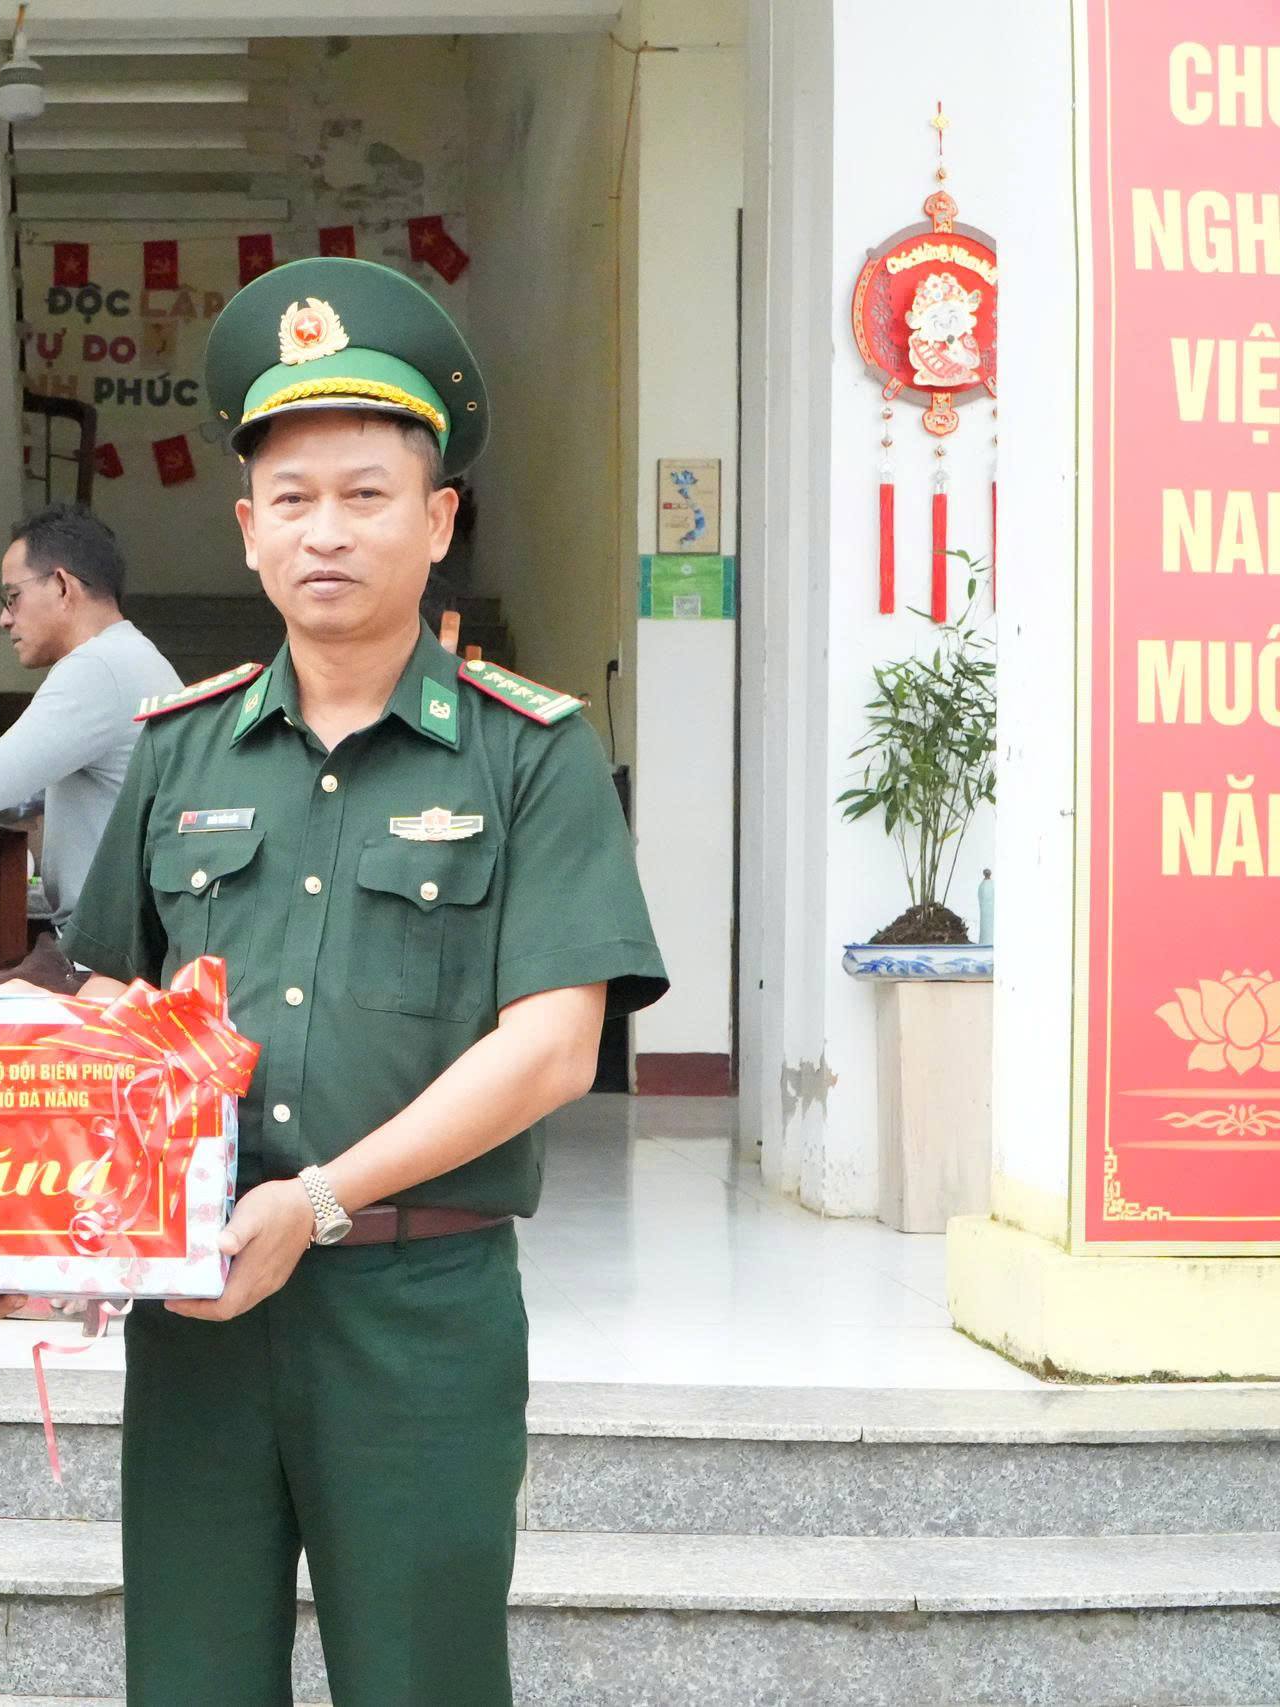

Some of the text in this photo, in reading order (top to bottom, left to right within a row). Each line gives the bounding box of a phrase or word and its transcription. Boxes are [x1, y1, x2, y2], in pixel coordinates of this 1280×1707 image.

[1169, 41, 1280, 127] CH
[1131, 187, 1280, 277] NGH
[45, 282, 131, 324] ĐỘC
[24, 327, 137, 368] Ự DO
[94, 372, 199, 407] PHÚC
[1169, 322, 1280, 445] VIỆ
[1161, 488, 1280, 575] NA
[1161, 773, 1280, 878] NĂ
[9, 1061, 36, 1084] ĐỘI
[40, 1061, 78, 1081] BIÊN
